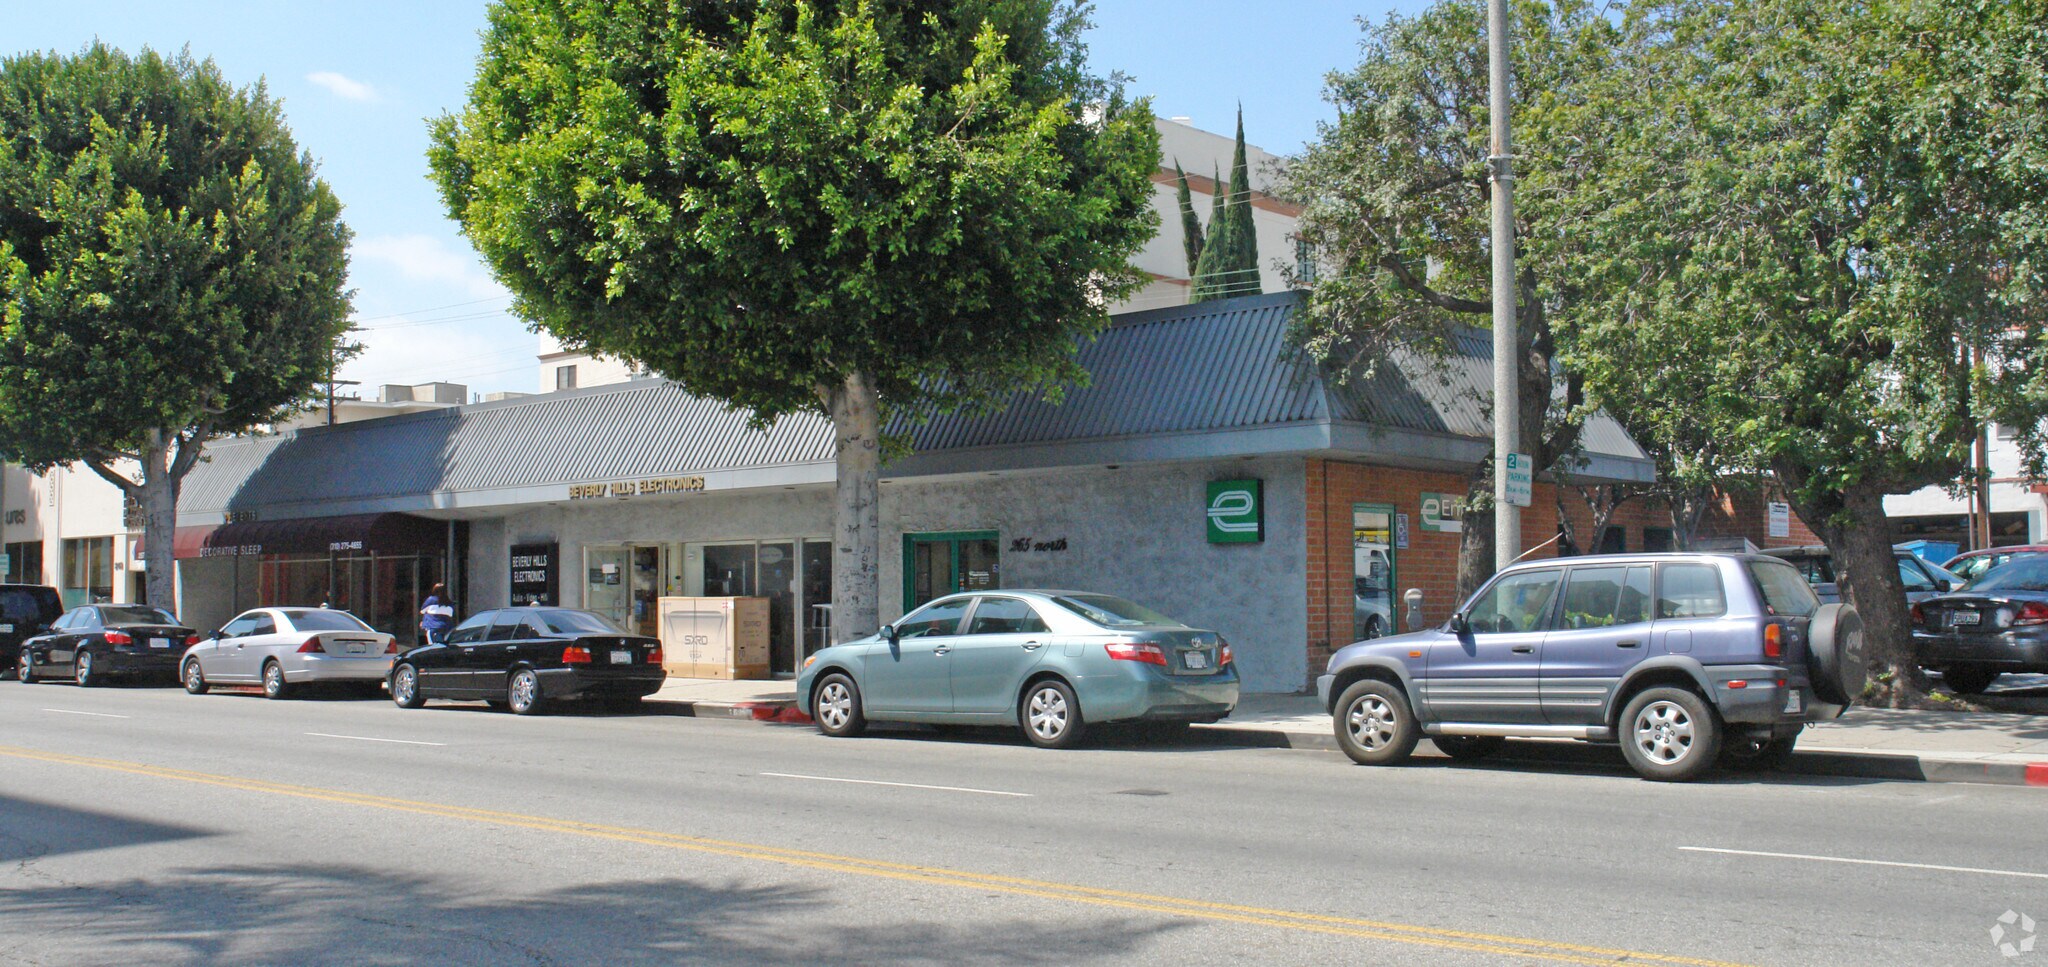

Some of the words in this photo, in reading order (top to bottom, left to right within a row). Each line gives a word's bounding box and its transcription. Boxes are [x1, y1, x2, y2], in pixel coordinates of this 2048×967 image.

[1508, 455, 1516, 467] 2
[569, 484, 607, 499] BEVERLY
[611, 481, 635, 497] HILLS
[639, 476, 705, 494] ELECTRONICS
[200, 546, 238, 558] DECORATIVE
[241, 544, 262, 556] SLEEP
[1033, 537, 1068, 551] north
[512, 555, 532, 568] BEVERLY
[533, 554, 548, 567] HILLS
[514, 570, 546, 583] ELECTRONICS
[684, 635, 708, 646] SXRD
